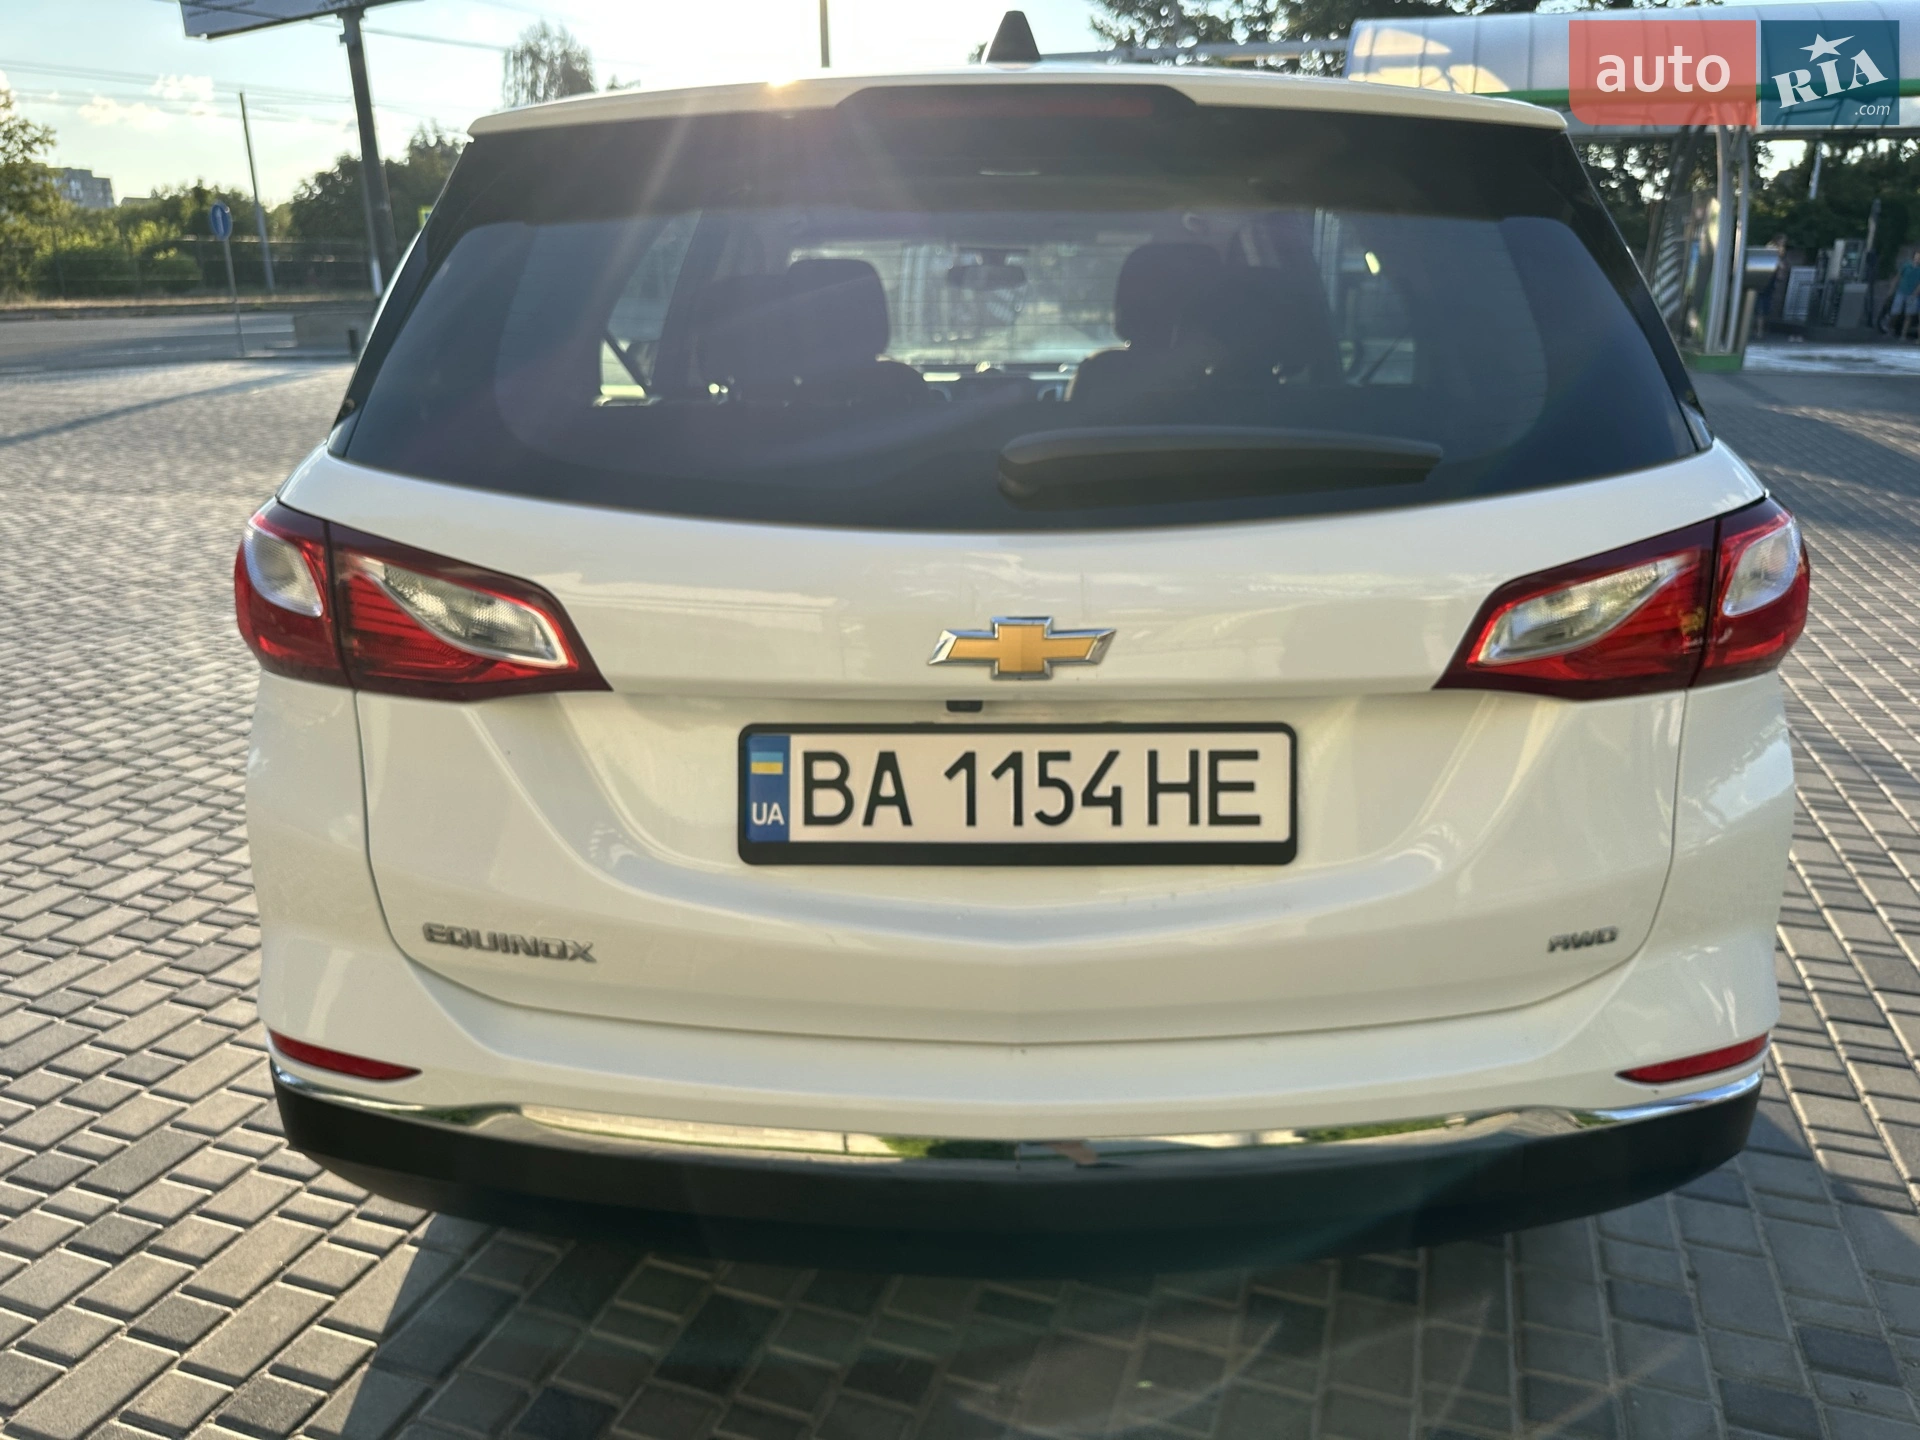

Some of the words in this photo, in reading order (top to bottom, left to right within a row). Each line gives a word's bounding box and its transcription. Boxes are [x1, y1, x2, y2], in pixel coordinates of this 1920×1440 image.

[802, 750, 913, 827] BA
[943, 750, 1122, 827] 1154
[1146, 749, 1261, 826] HE
[751, 802, 785, 826] UA
[422, 922, 597, 963] EQUINOX
[1547, 925, 1618, 953] AWD
